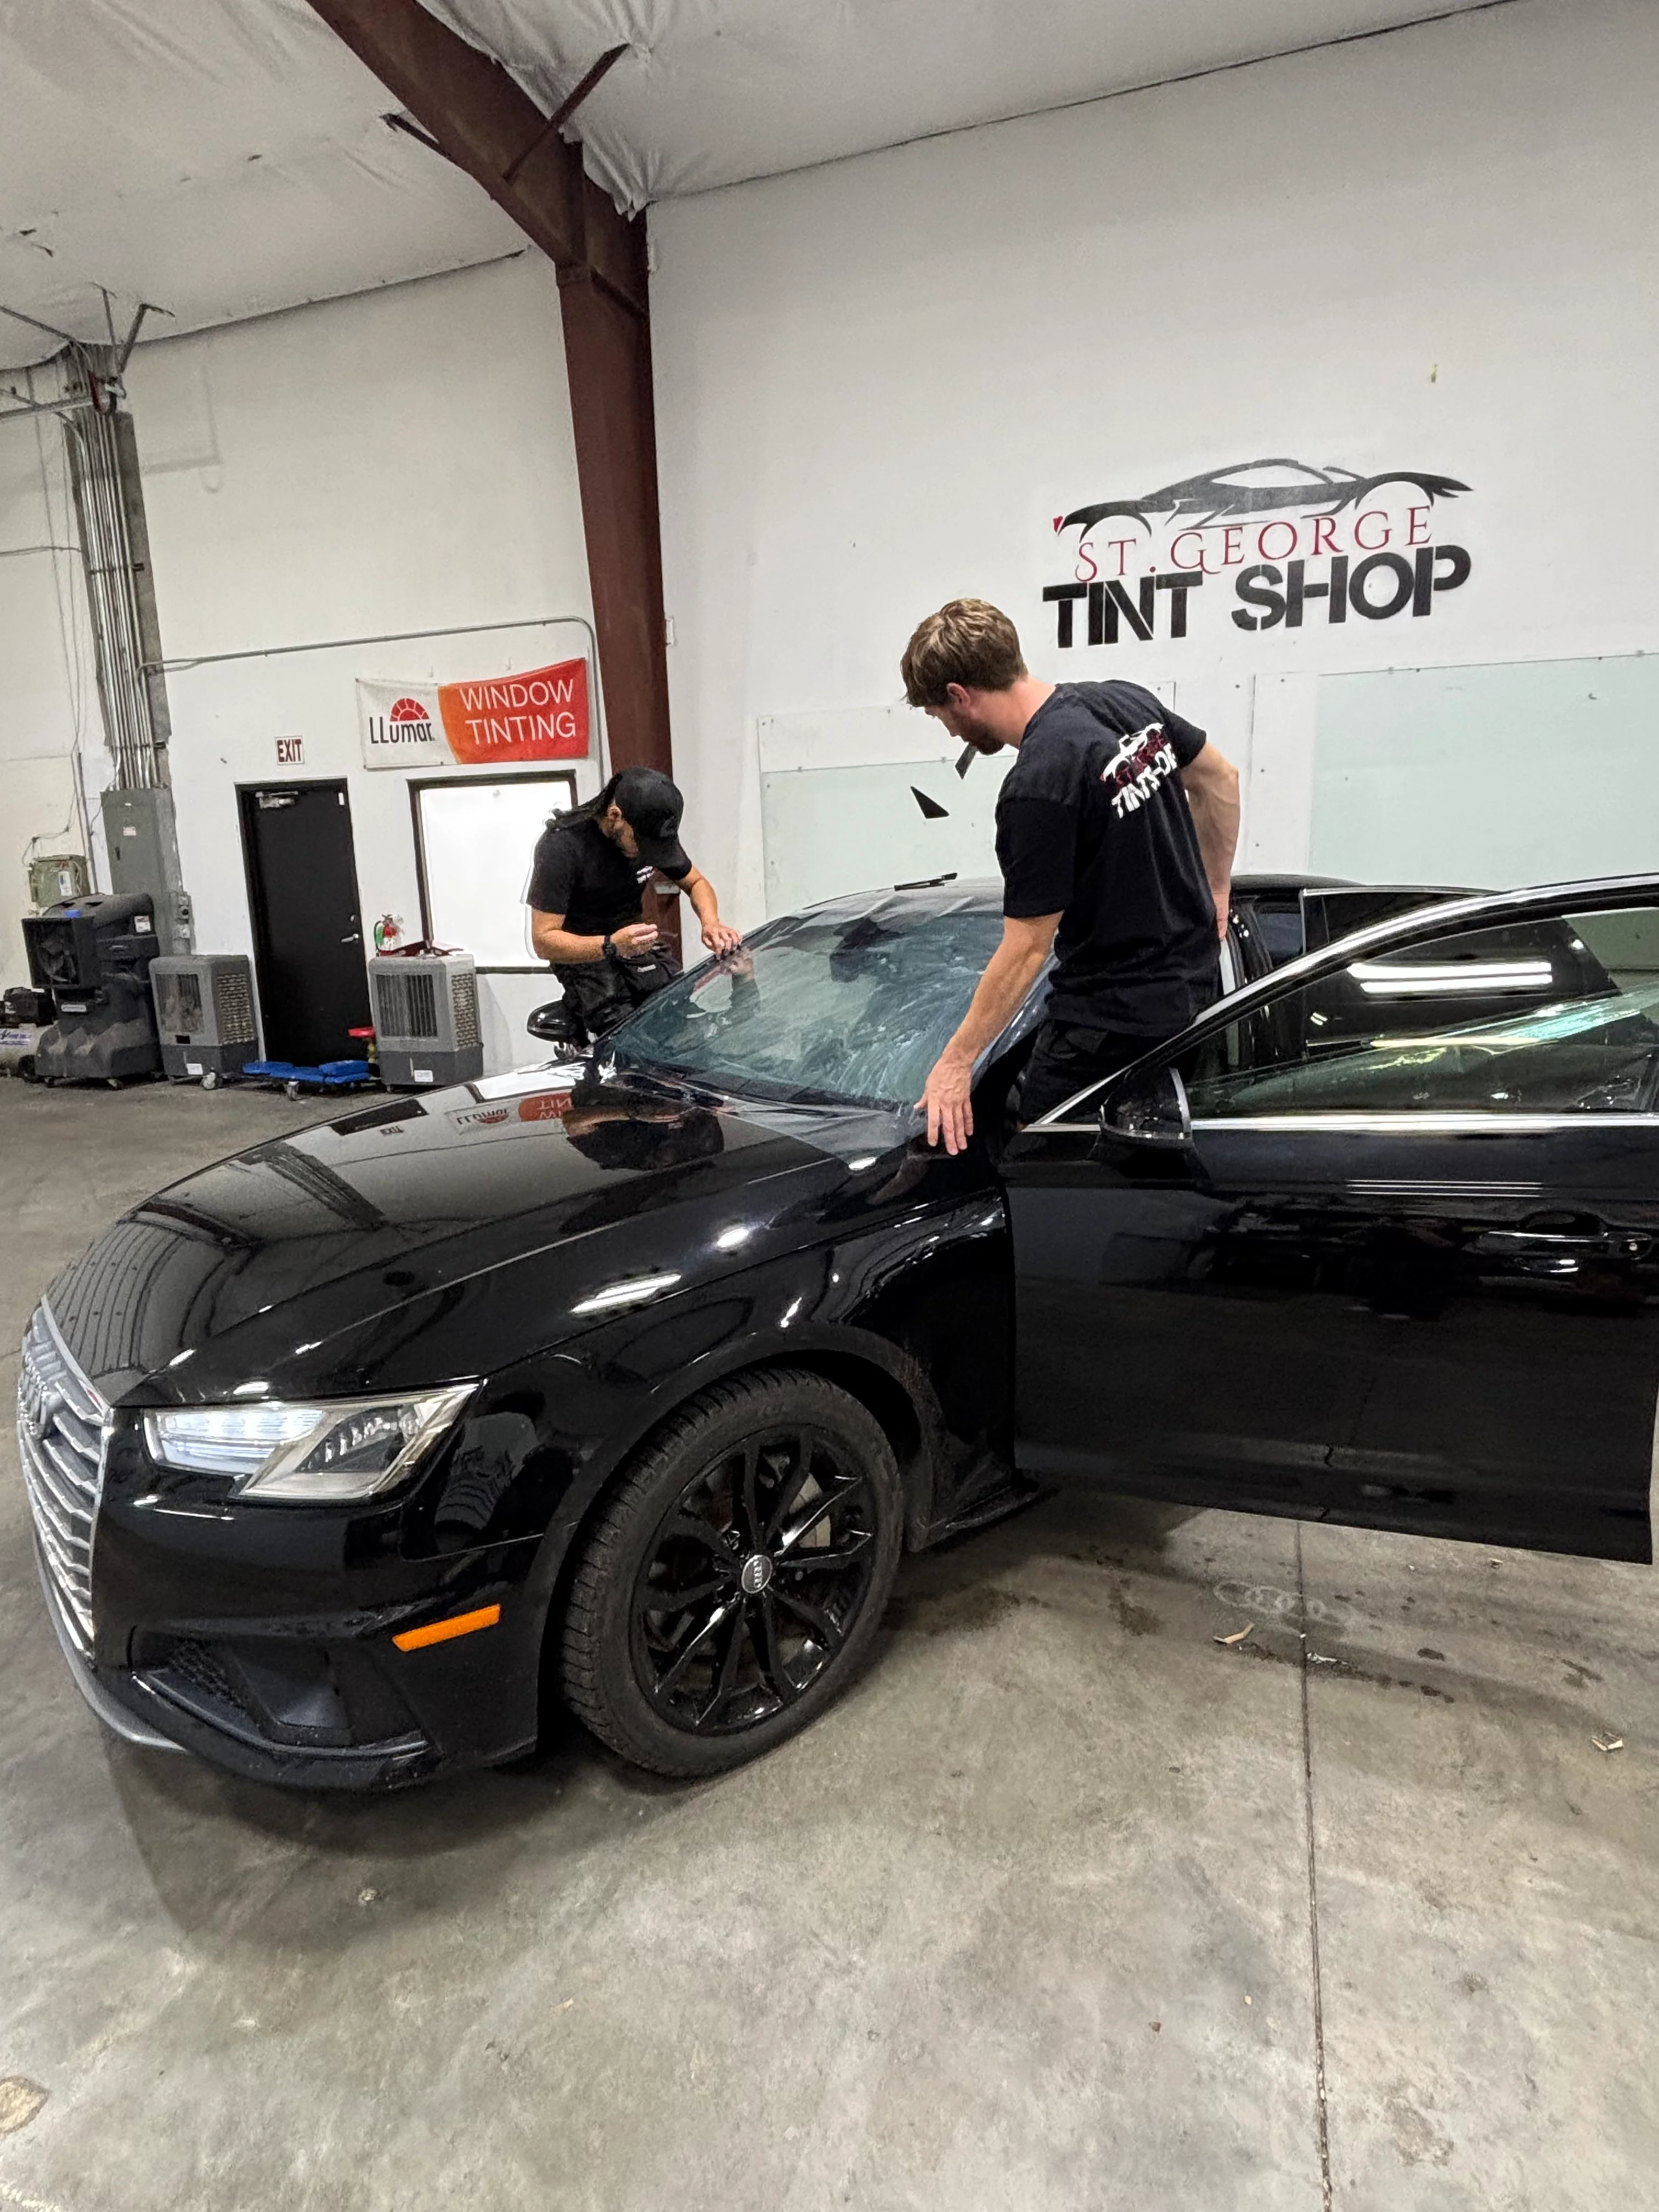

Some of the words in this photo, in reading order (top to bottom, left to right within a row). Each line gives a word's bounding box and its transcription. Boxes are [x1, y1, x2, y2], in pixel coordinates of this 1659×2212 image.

[1042, 570, 1203, 648] TINT
[1231, 545, 1471, 631] SHOP
[459, 679, 574, 712] WINDOW
[369, 716, 433, 744] LLumar
[465, 711, 575, 745] TINTING
[276, 738, 302, 763] EXIT
